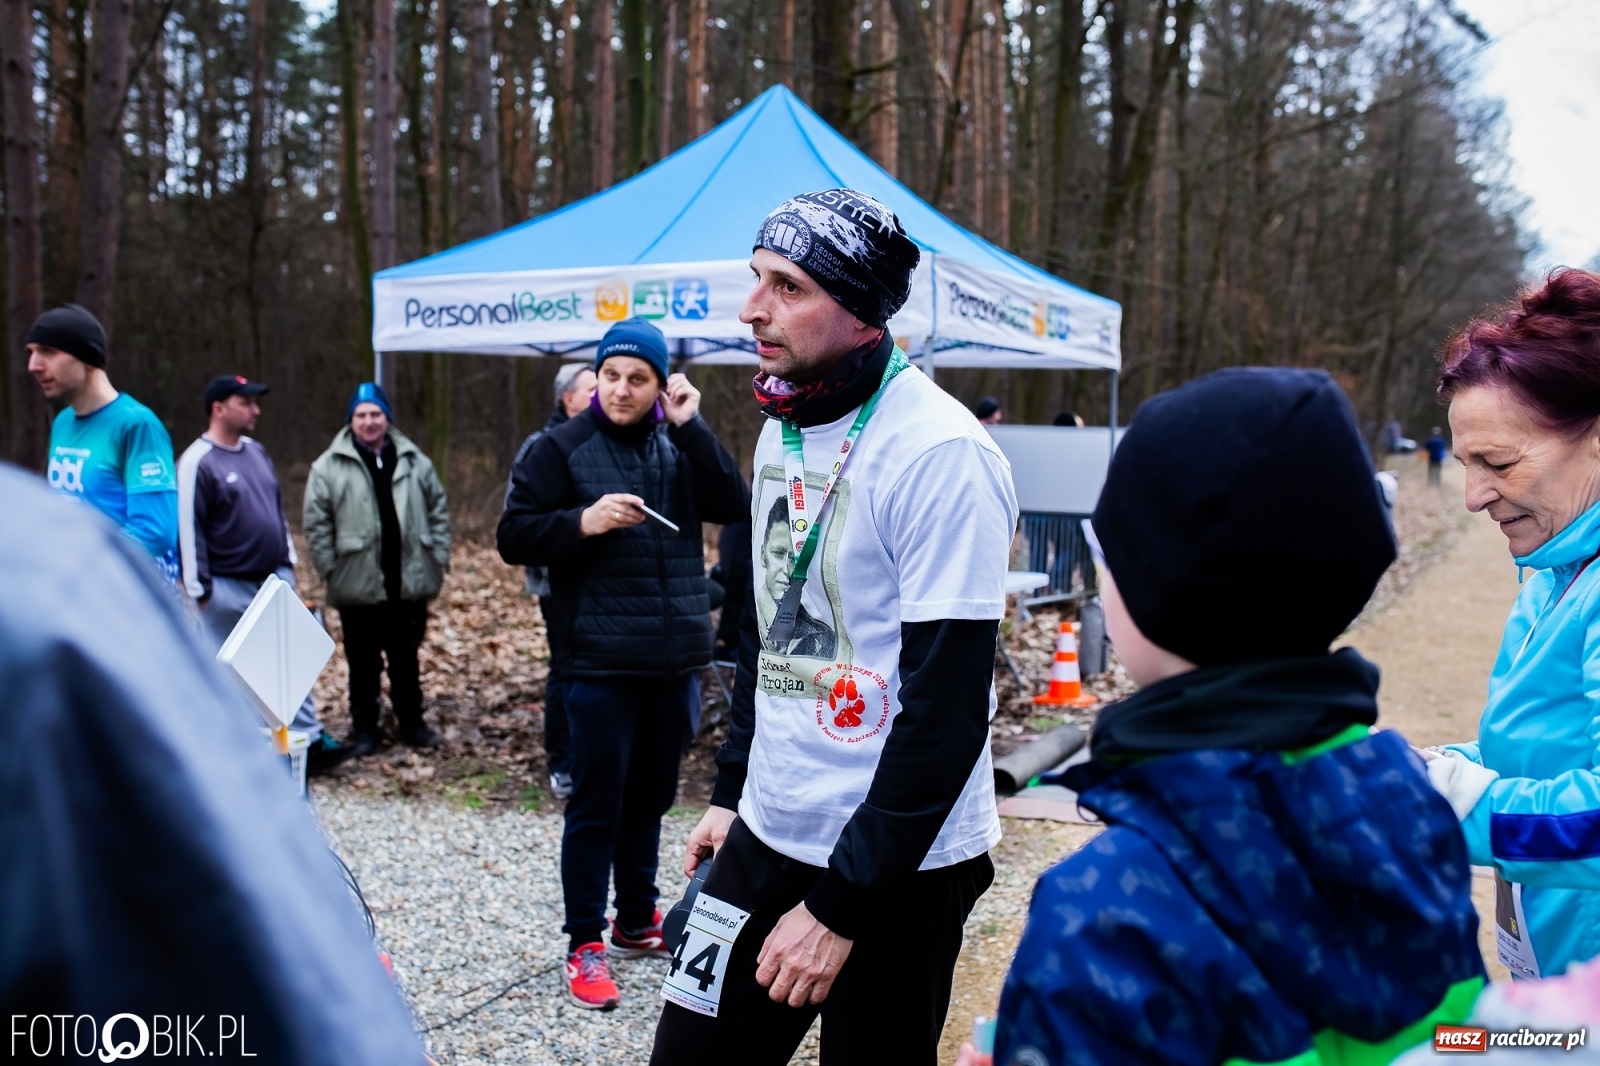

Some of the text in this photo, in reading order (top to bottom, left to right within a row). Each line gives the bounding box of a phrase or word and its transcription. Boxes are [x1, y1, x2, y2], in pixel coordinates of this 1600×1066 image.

[405, 290, 582, 328] PersonalBest
[760, 657, 792, 672] Józef
[761, 674, 805, 693] Trojan
[872, 673, 888, 690] 2020
[693, 905, 738, 929] personalbest.pl
